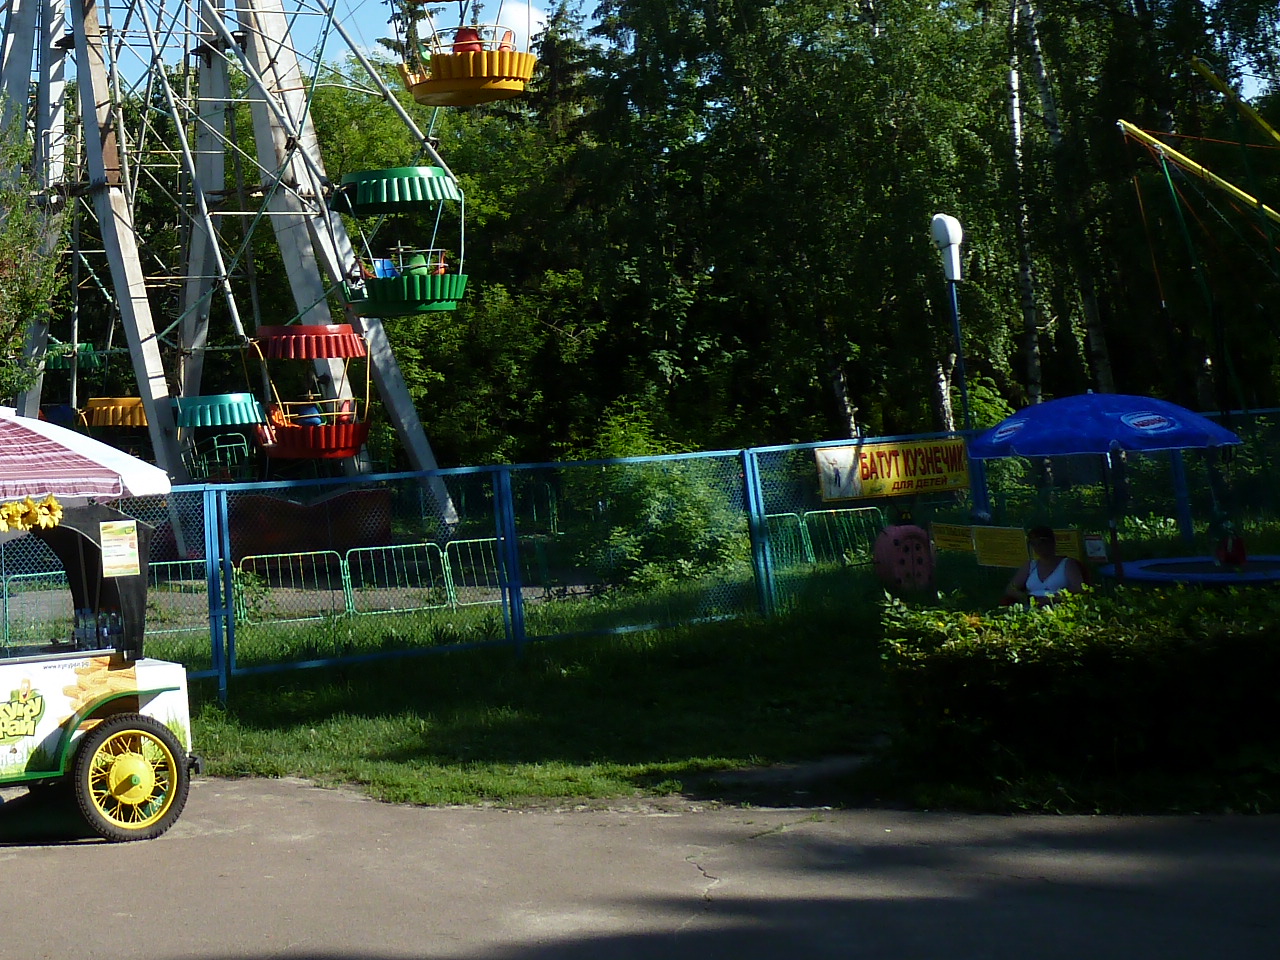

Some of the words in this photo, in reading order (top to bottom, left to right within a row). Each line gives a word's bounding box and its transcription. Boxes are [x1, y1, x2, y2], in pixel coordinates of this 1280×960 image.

[859, 450, 900, 481] БАТУТ
[901, 444, 965, 477] КУЗНЕЧИК
[892, 480, 914, 491] ДЛЯ
[915, 475, 948, 489] ДЕТЕЙ
